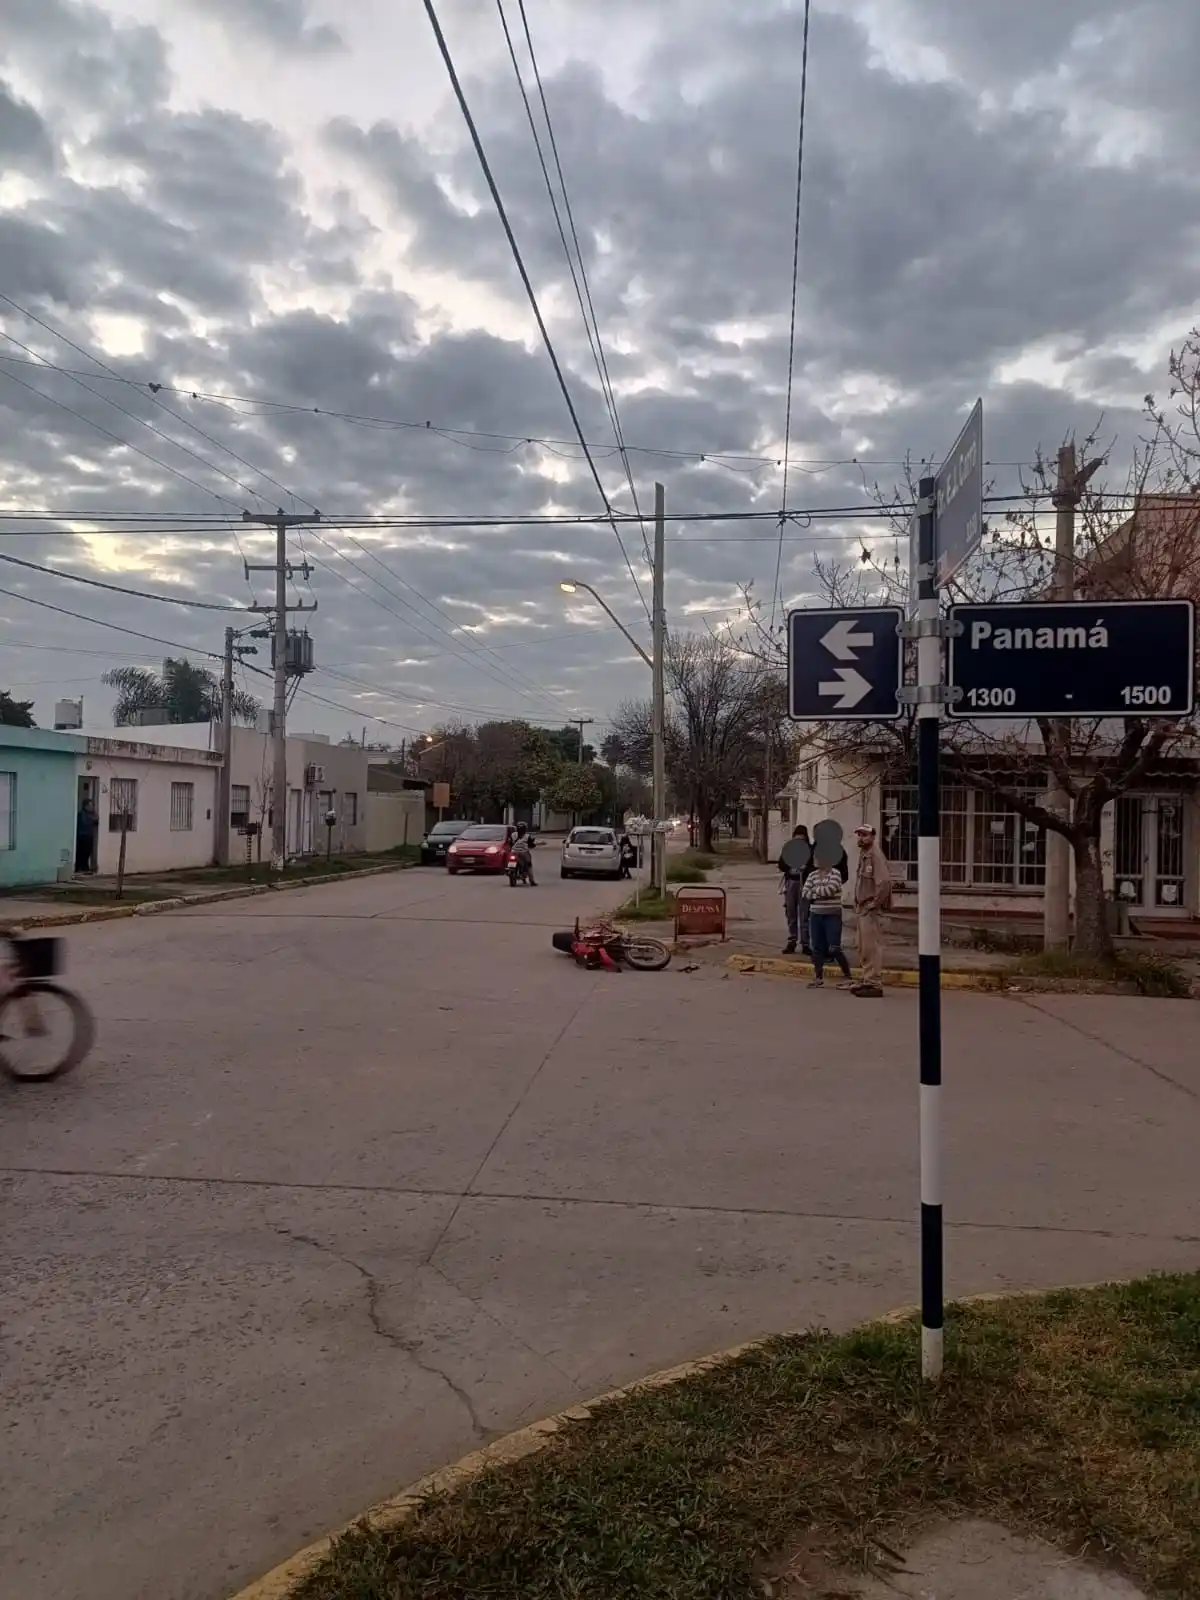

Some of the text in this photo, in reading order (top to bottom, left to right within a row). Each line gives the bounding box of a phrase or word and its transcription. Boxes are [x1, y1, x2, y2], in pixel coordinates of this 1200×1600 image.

[971, 619, 1109, 650] Panamá
[967, 687, 1016, 706] 1300
[1120, 686, 1172, 705] 1500
